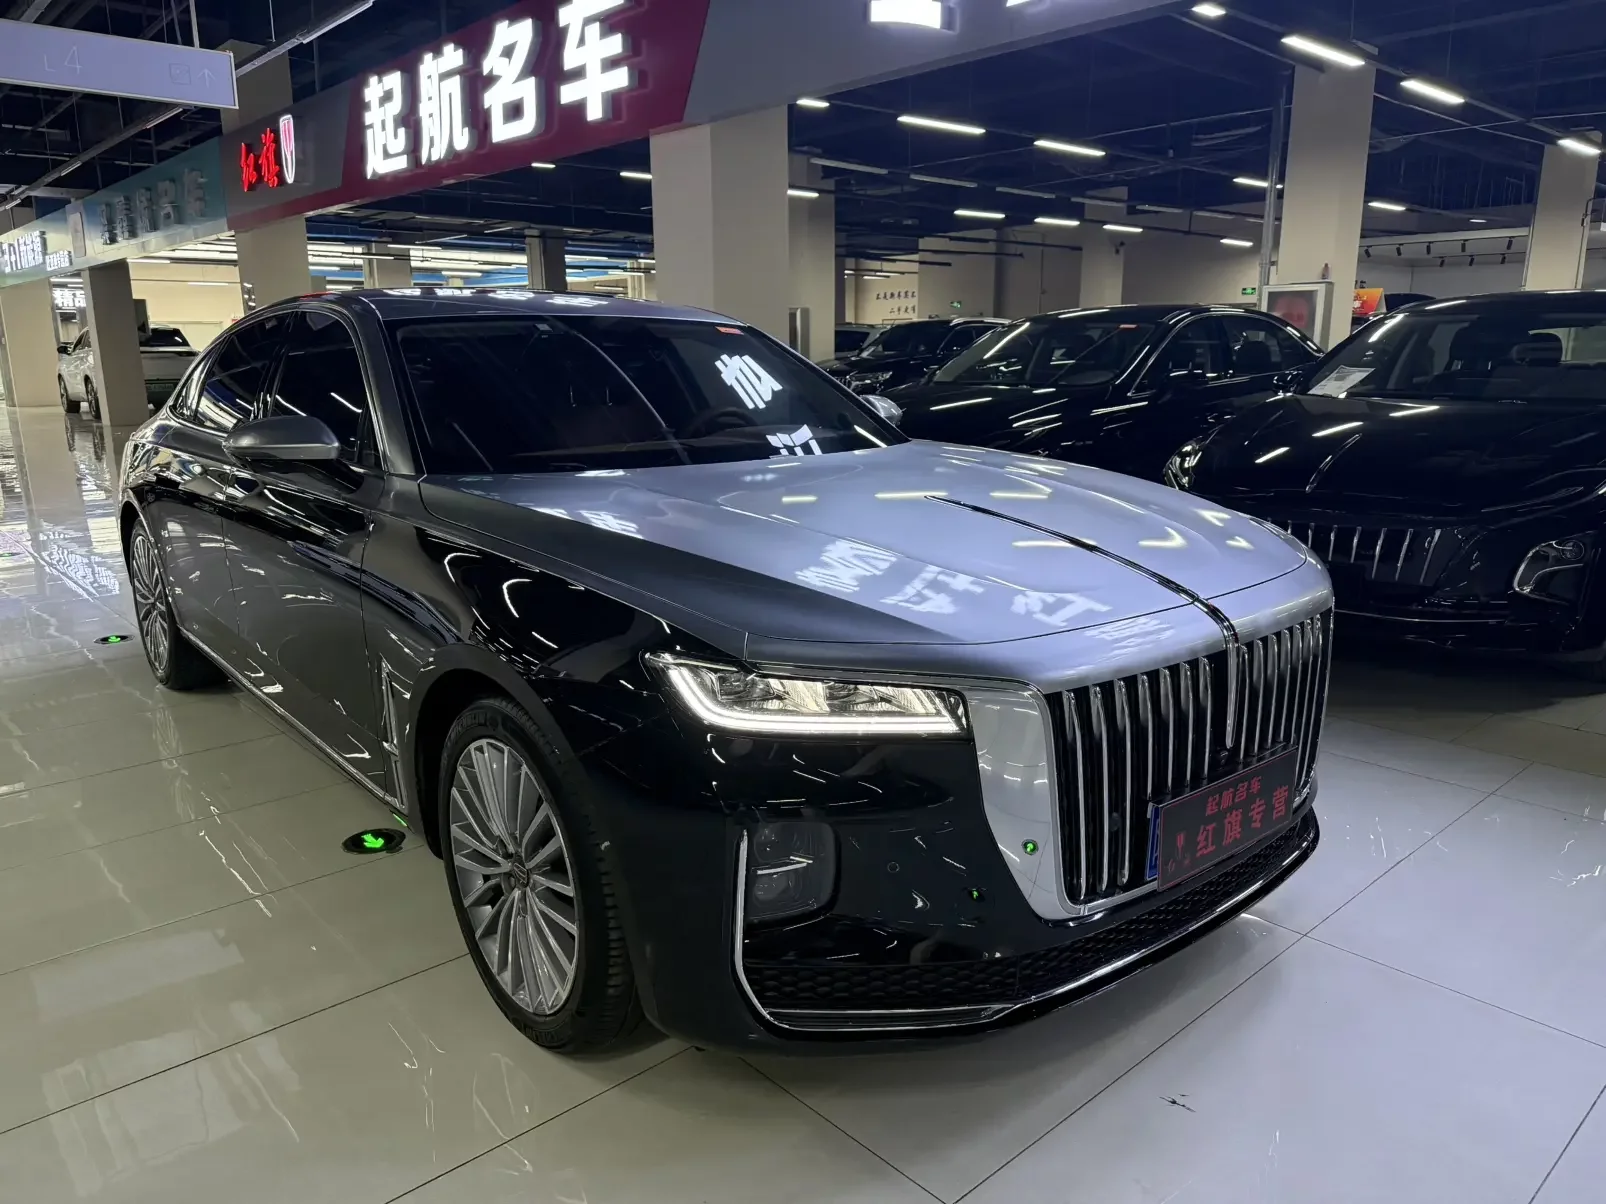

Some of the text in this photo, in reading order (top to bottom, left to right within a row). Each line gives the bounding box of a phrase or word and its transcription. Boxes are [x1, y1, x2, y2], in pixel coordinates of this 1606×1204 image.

[364, 0, 629, 180] 起航名车
[240, 127, 280, 193] 红旗
[1195, 785, 1289, 858] 红旗专营
[1205, 775, 1262, 817] 起航名车
